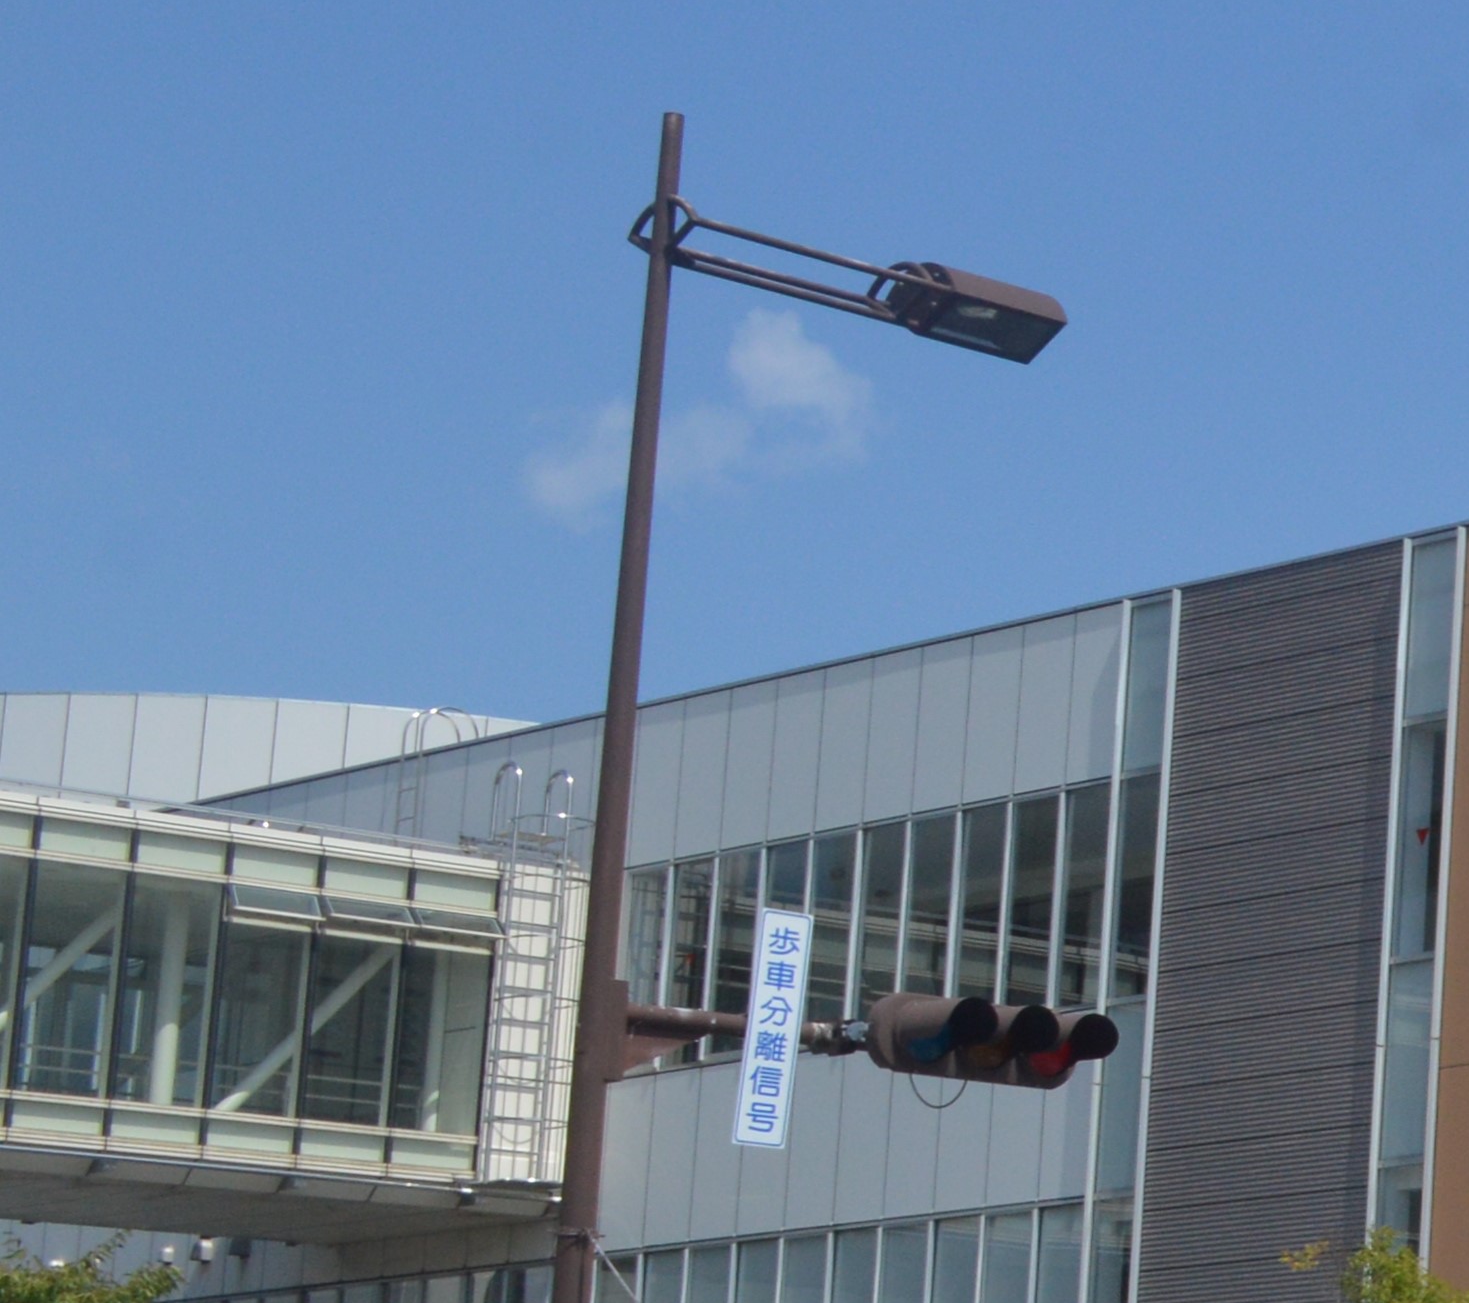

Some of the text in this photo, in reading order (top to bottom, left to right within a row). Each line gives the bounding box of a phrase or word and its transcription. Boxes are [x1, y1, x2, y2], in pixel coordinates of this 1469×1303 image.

[746, 926, 801, 1133] 歩車分離信号
